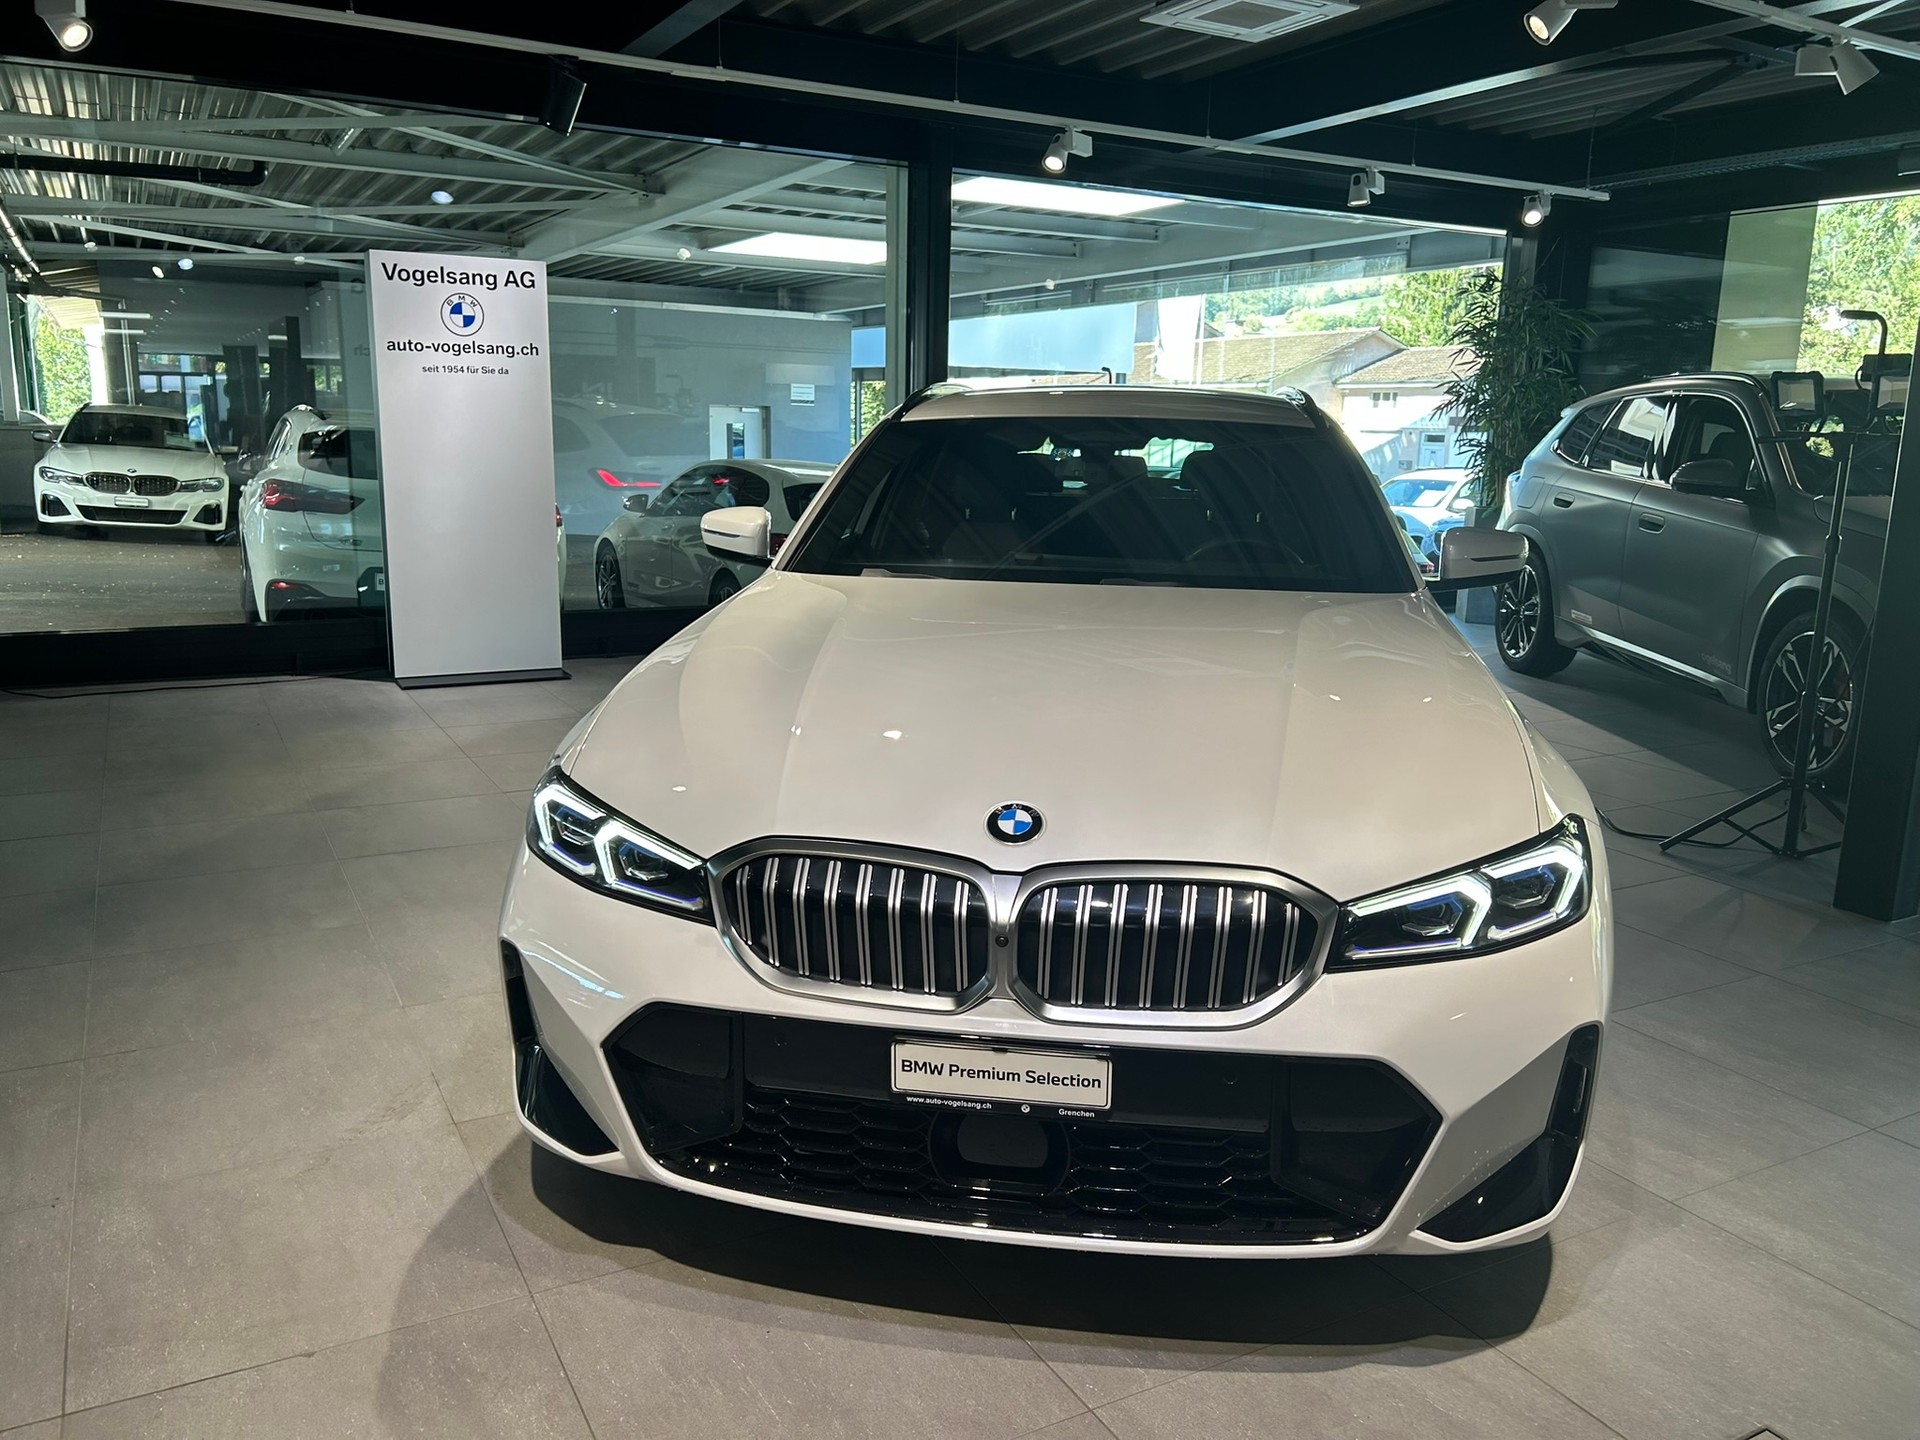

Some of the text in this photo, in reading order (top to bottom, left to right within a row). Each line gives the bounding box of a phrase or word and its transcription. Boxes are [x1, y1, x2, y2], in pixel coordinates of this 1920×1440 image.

[381, 262, 535, 291] Vogelsang AG
[446, 295, 477, 308] BMW
[387, 339, 539, 358] auto-vogelsang.ch
[422, 365, 509, 375] seit 1954 für Sie da
[901, 1059, 1102, 1089] BMW Premium Selection
[906, 1096, 1095, 1118] www.auto-vogelsang.ch Grenchen
